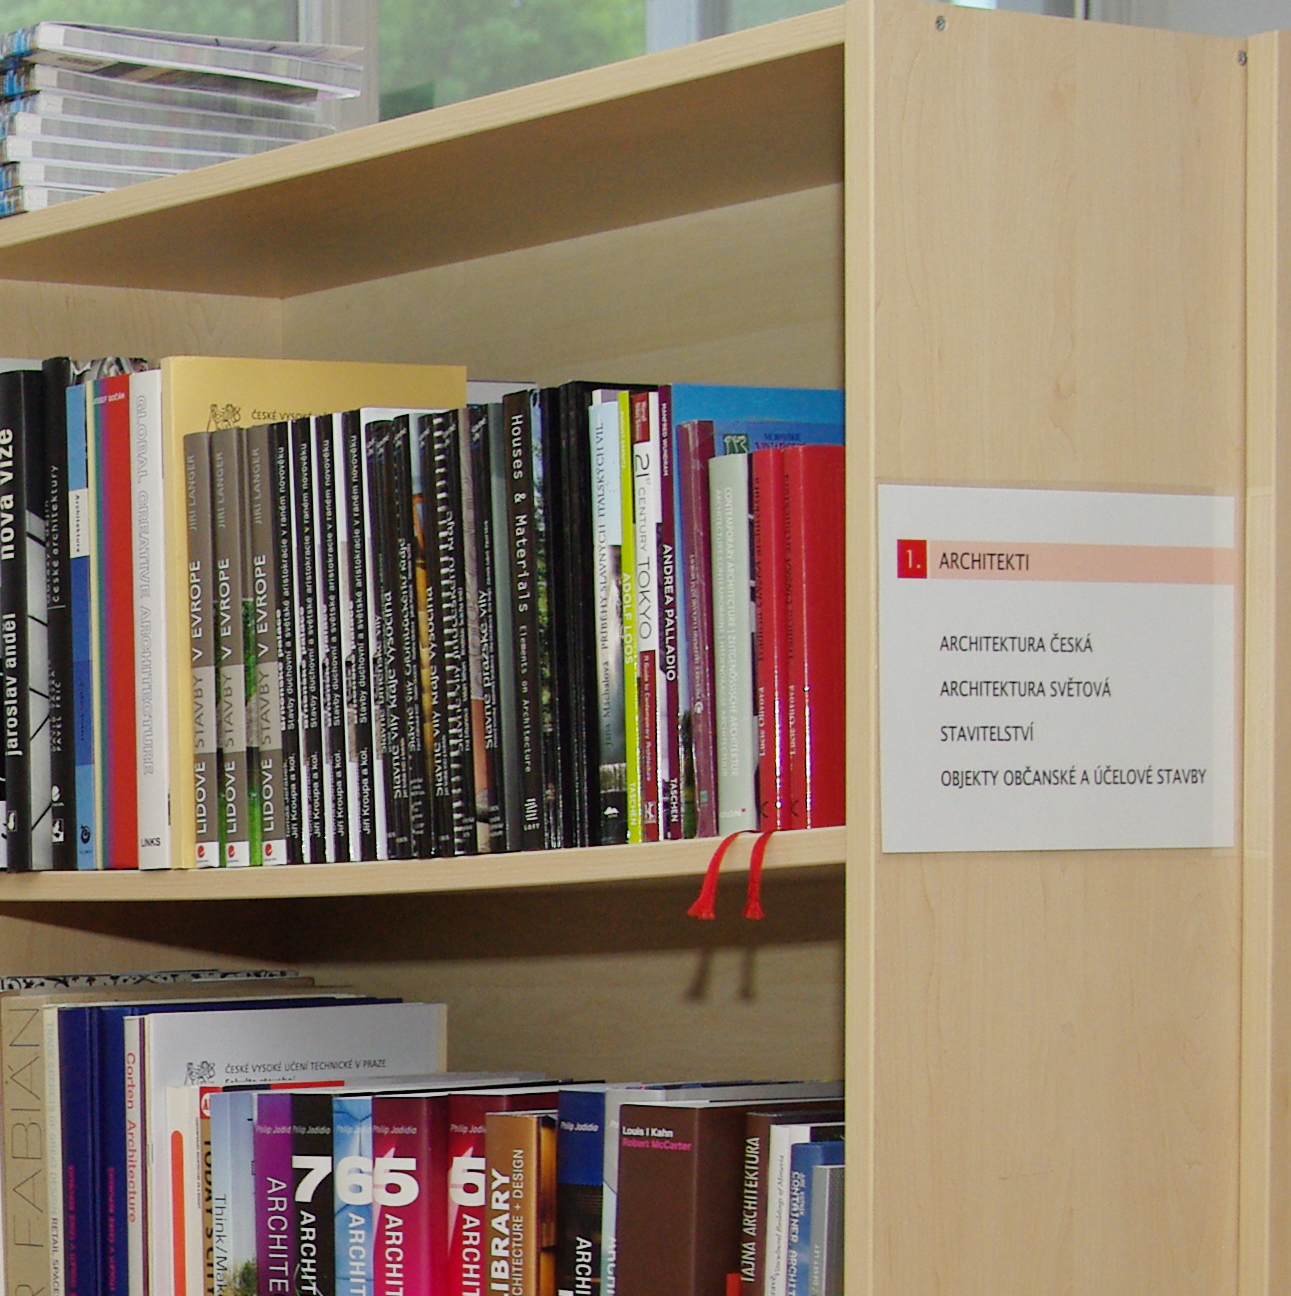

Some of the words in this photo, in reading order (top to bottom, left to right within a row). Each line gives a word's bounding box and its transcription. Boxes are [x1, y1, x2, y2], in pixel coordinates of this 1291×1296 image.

[511, 414, 524, 481] Houses
[514, 492, 524, 503] &
[0, 484, 14, 560] nová
[515, 514, 528, 613] Materials
[662, 543, 673, 606] ANDREA
[905, 549, 921, 569] 1.
[939, 552, 1029, 571] ARCHITEKTI
[622, 572, 633, 617] ADOLF
[2, 612, 17, 651] anděl
[624, 622, 634, 664] LOOS
[664, 608, 676, 682] PALLADIO
[940, 635, 1046, 653] ARCHITEKTURA
[1050, 633, 1093, 653] ČESKÁ
[7, 657, 23, 757] jaroslav
[940, 680, 1046, 697] ARCHITEKTURA
[1050, 677, 1111, 697] SVĚTOVÁ
[940, 722, 1034, 742] STAVITELSTVÍ
[941, 770, 999, 788] OBJEKTY
[1004, 765, 1076, 786] OBČANSKÉ
[1081, 770, 1090, 785] A
[1094, 764, 1153, 785] ÚČELOVÉ
[1157, 768, 1206, 784] STAVBY
[8, 1008, 45, 1248] FABIÁN
[622, 1126, 644, 1137] Louis
[647, 1128, 650, 1136] I
[652, 1127, 673, 1138] Kahn
[623, 1139, 649, 1149] Robert
[652, 1140, 692, 1152] McCarter
[292, 1156, 332, 1202] 7
[336, 1156, 373, 1205] 6
[373, 1157, 419, 1206] 5
